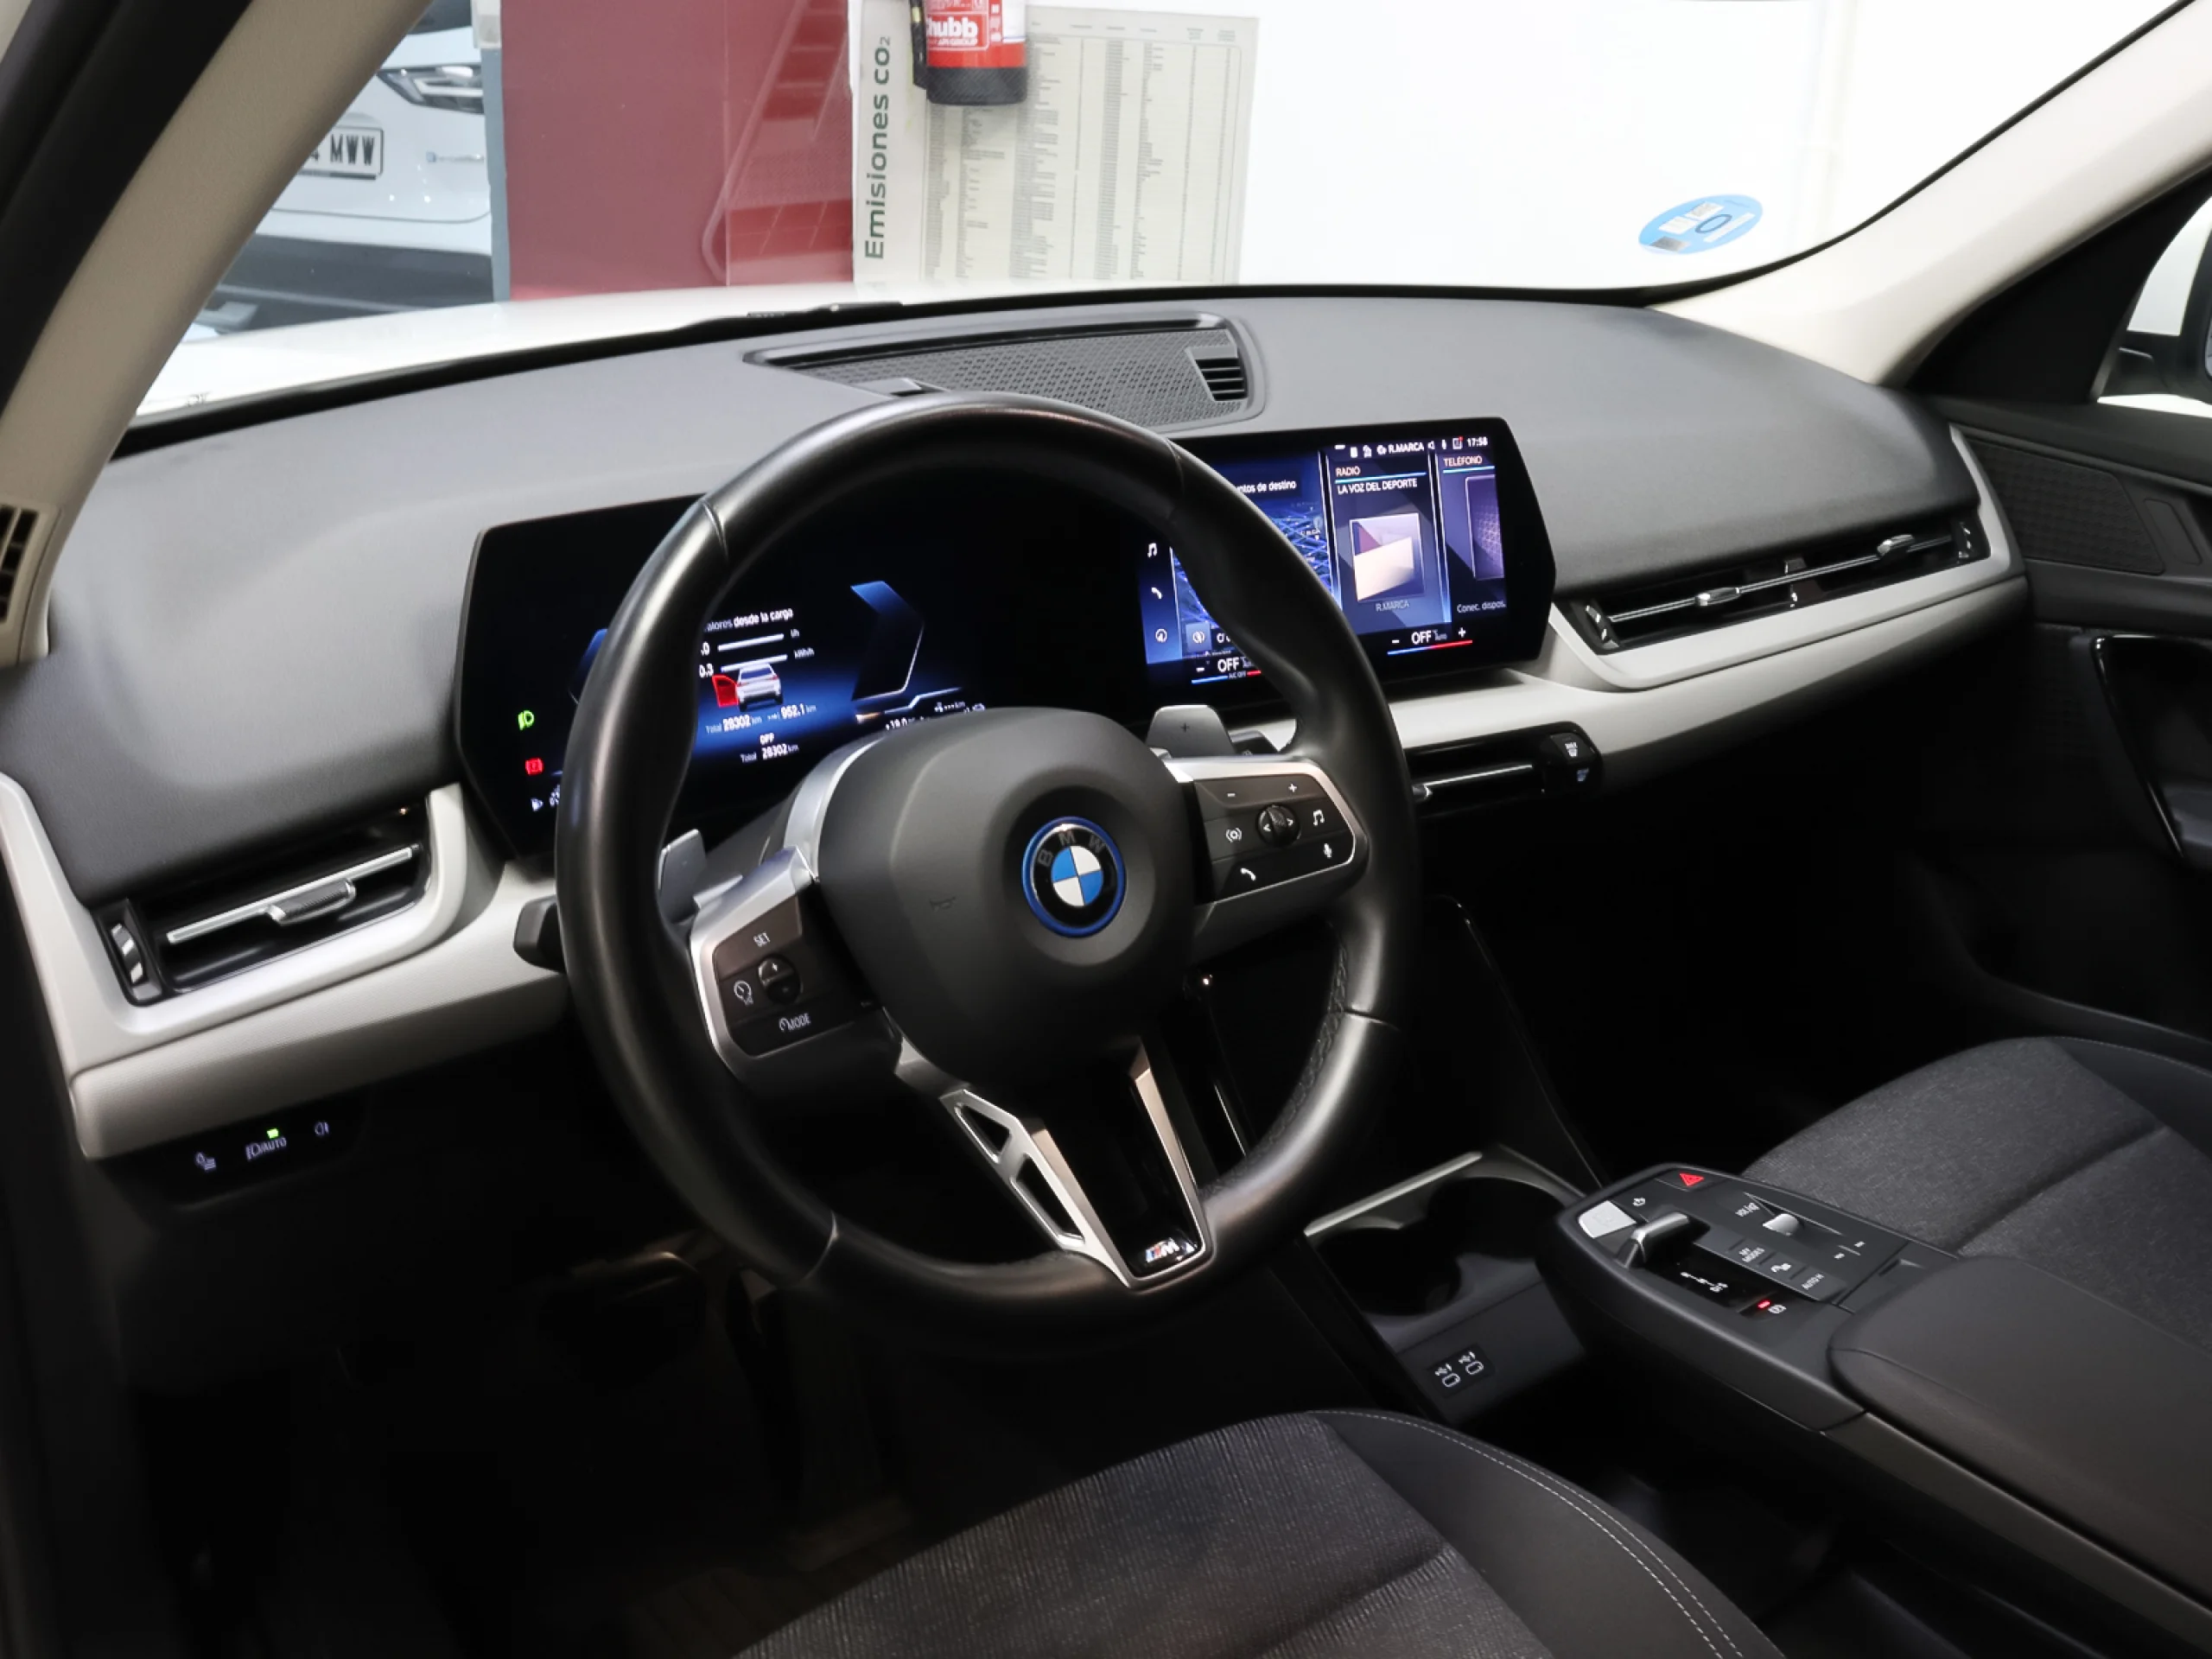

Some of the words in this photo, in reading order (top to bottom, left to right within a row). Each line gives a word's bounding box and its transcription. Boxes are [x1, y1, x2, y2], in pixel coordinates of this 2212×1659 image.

[925, 16, 978, 37] hubb
[330, 134, 375, 166] MWW
[865, 93, 889, 259] Emisiones
[1335, 466, 1361, 477] RADIO
[1268, 480, 1296, 492] destino
[1338, 485, 1348, 495] LA
[1349, 482, 1365, 493] VOZ
[1366, 480, 1382, 493] DEL
[1382, 478, 1417, 491] DEPORTE
[734, 613, 760, 628] desde
[770, 607, 793, 622] carga
[1411, 630, 1432, 645] OFF
[1217, 657, 1239, 672] OFF
[1038, 830, 1106, 867] BMW
